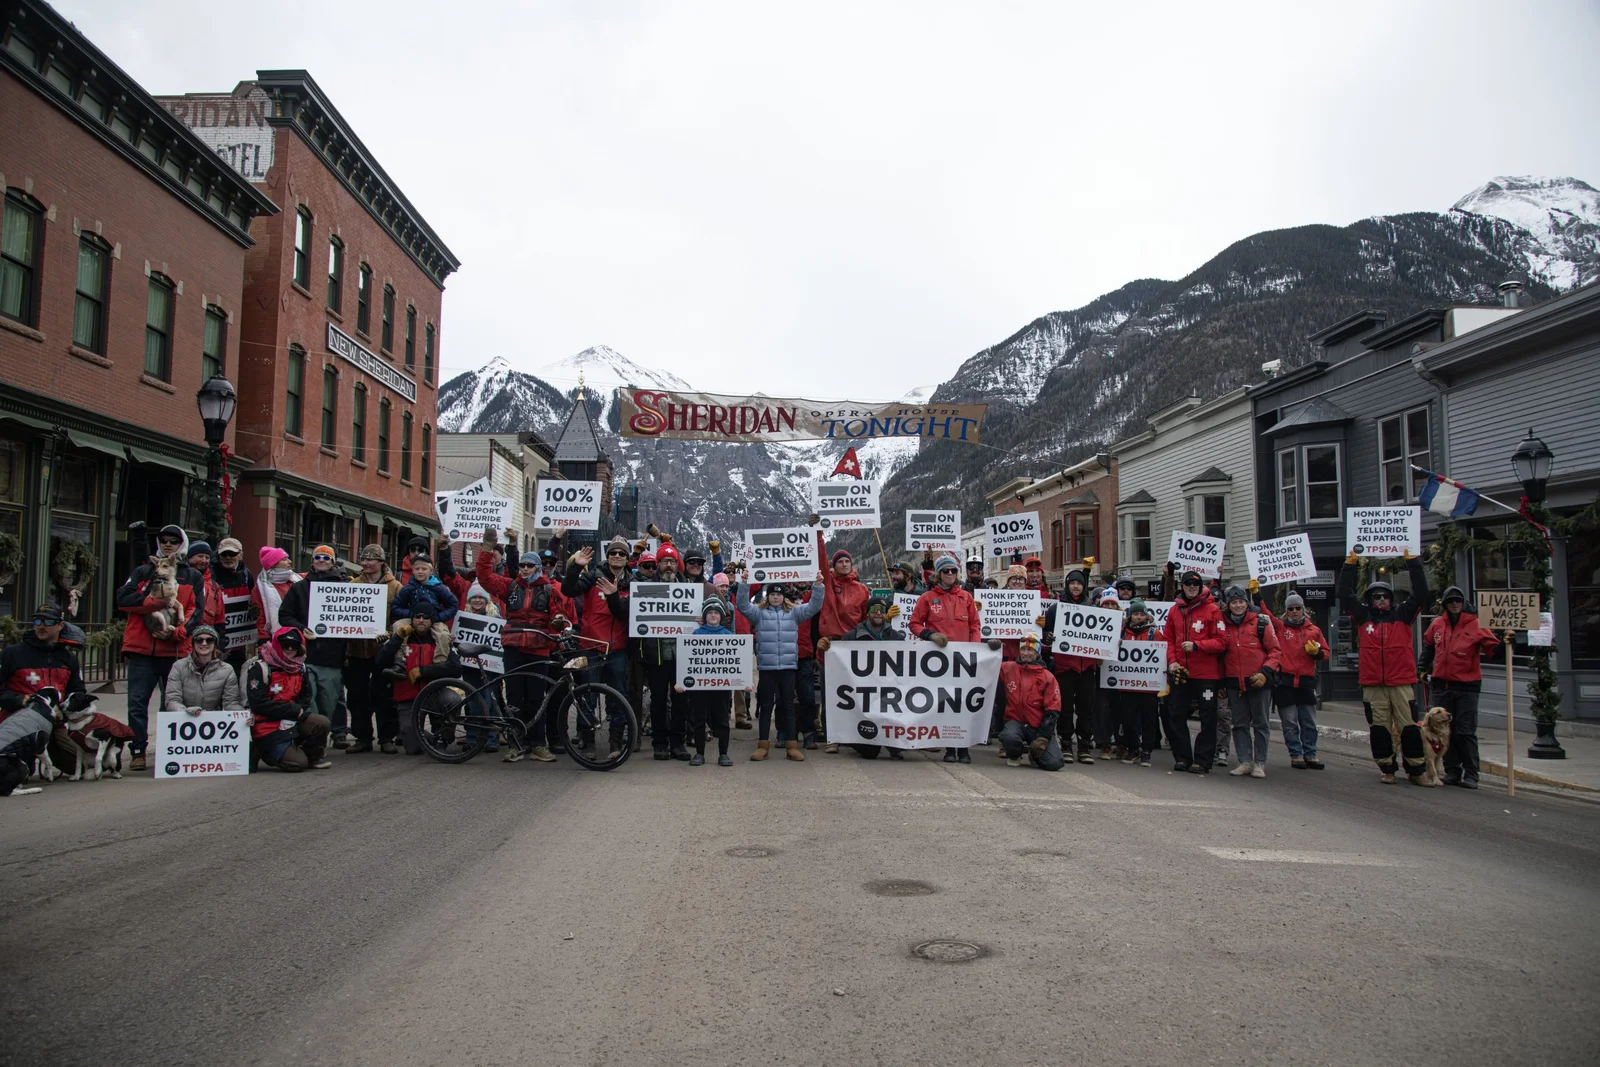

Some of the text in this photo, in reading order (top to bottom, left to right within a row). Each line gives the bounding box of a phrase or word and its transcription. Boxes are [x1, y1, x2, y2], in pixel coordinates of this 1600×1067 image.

[169, 101, 265, 128] RIDAN
[216, 143, 264, 177] OTEL
[330, 329, 414, 399] NEW SHERIDAN
[629, 390, 798, 438] SHERIDAN
[810, 408, 960, 418] OPERA HOUSE
[821, 417, 978, 441] TONIGHT
[466, 484, 484, 497] ON
[545, 487, 593, 503] 100%
[850, 485, 871, 495] ON
[453, 498, 479, 506] HONK
[489, 500, 508, 508] YOU
[820, 497, 871, 508] STRIKE,
[460, 506, 500, 515] SUPPORT
[543, 505, 592, 513] SOLIDARITY
[1353, 510, 1381, 518] HONK
[456, 514, 502, 523] TELLURIDE
[552, 519, 580, 527] TPSPA
[832, 519, 862, 527] TPSPA
[937, 514, 955, 522] ON
[1361, 518, 1405, 526] SUPPORT
[454, 521, 501, 531] SKI PATROL
[912, 524, 954, 534] STRIKE,
[991, 518, 1034, 535] 100%
[1358, 526, 1408, 534] TELLURIDE
[461, 532, 484, 540] TPSP
[786, 532, 809, 544] ON
[992, 533, 1034, 544] SOLIDARITY
[1177, 538, 1218, 556] 100%
[1250, 542, 1276, 552] HONK
[1284, 537, 1303, 546] YOU
[1366, 545, 1398, 553] TPSPA
[755, 546, 809, 559] STRIKE,
[1259, 545, 1297, 558] SUPPORT
[1175, 552, 1216, 565] SOLIDARITY
[1257, 552, 1302, 566] TELLURIDE
[1258, 559, 1305, 574] SKI PATROL
[767, 571, 800, 580] TPSPA
[1268, 571, 1298, 582] TPSPA
[317, 586, 347, 595] HONK
[672, 588, 695, 599] ON
[325, 595, 372, 604] SUPPORT
[900, 597, 918, 605] HON
[1015, 593, 1035, 601] YOU
[1480, 594, 1536, 608] LIVABLE
[321, 604, 375, 613] TELLURIDE
[638, 601, 694, 614] STRIKE,
[985, 609, 1031, 617] TELLURIDE
[1491, 607, 1528, 620] WAGES
[319, 614, 376, 623] SKI PATROL
[984, 617, 1033, 625] SKI PATROL
[1063, 611, 1114, 632] 100%
[1489, 619, 1528, 629] PLEASE
[329, 626, 363, 635] TPSPA
[650, 626, 683, 635] TPSPA
[993, 628, 1023, 636] TPSPA
[231, 634, 252, 645] TPSPA
[457, 630, 503, 650] STRIKE,
[1061, 629, 1113, 643] SOLIDARITY
[692, 648, 738, 656] SUPPORT
[1071, 644, 1100, 656] TPSPA
[688, 657, 741, 665] TELLURIDE
[1118, 648, 1160, 664] 00%
[850, 650, 977, 678] UNION
[686, 666, 742, 674] SKI PATROL
[1108, 665, 1160, 674] SOLIDARITY
[697, 678, 731, 687] TPSPA
[1118, 679, 1148, 688] TPSPA
[836, 684, 988, 714] STRONG
[167, 721, 239, 741] 100%
[881, 725, 941, 741] TPSPA
[167, 744, 239, 755] SOLIDARITY
[182, 763, 224, 773] TPSPA
